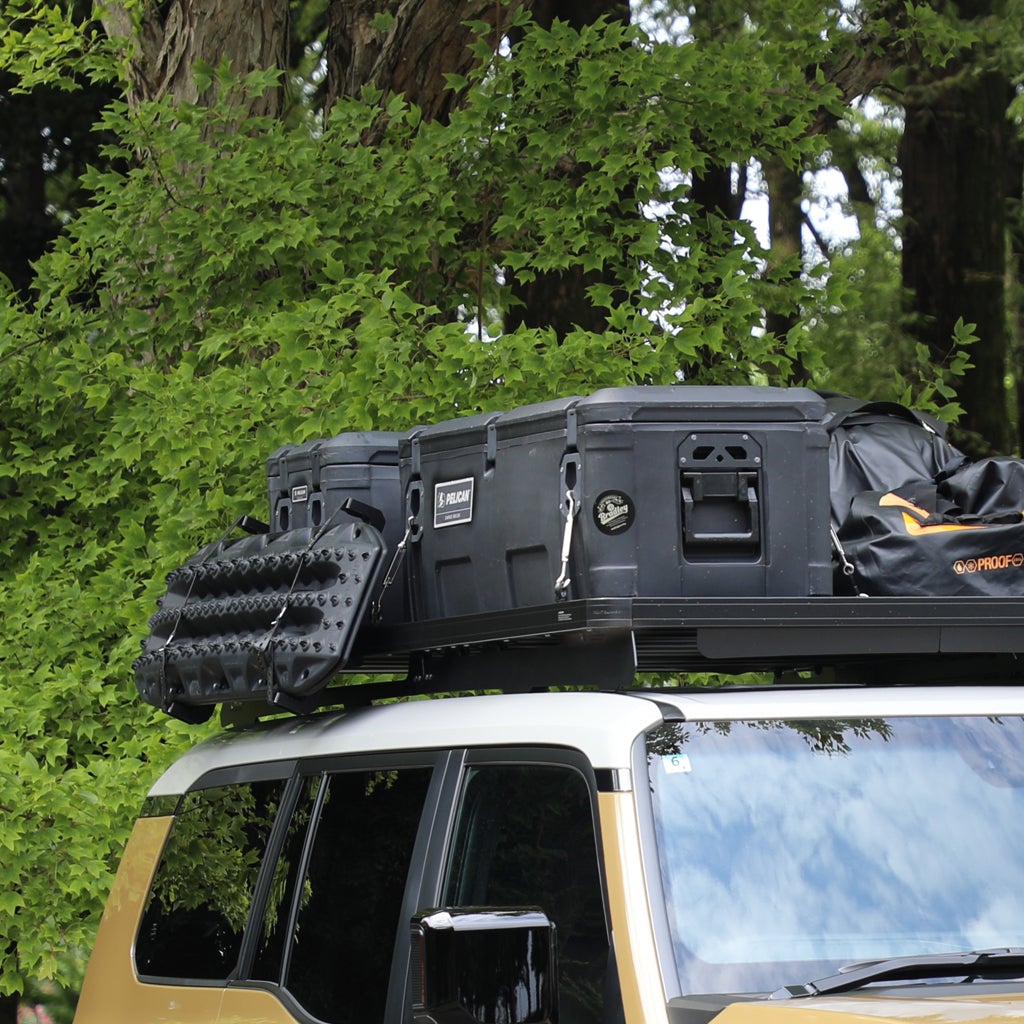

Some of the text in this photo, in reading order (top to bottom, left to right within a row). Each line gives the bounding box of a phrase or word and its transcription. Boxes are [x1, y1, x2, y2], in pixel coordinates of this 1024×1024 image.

[445, 489, 471, 505] PELICAN
[597, 504, 629, 525] Bradley
[977, 554, 1013, 571] PROOF
